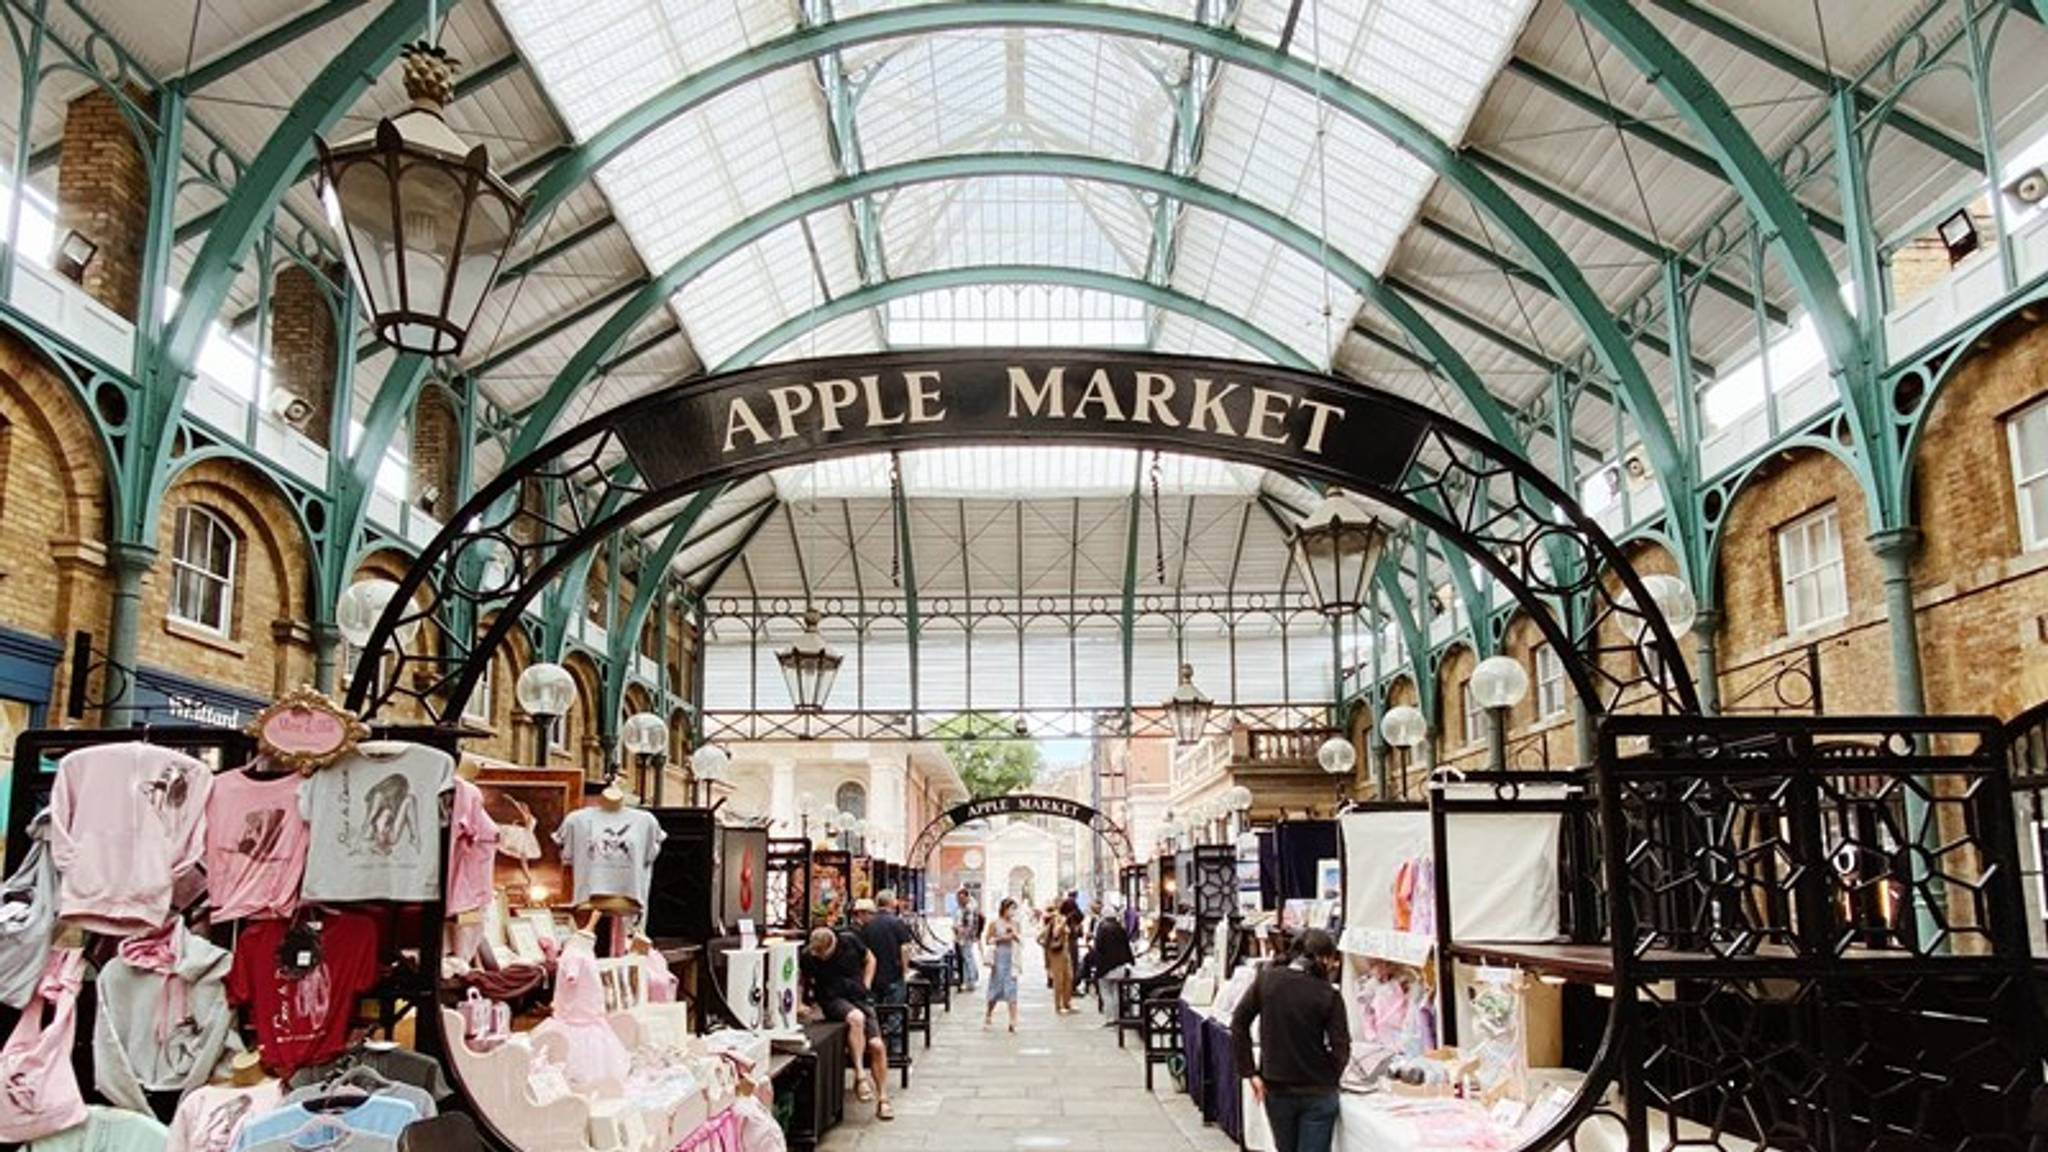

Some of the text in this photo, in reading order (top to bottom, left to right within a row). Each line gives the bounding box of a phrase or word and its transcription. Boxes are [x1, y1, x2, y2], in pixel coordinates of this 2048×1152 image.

[722, 366, 1346, 455] APPLE MARKET
[967, 798, 1080, 817] APPLE MARKET
